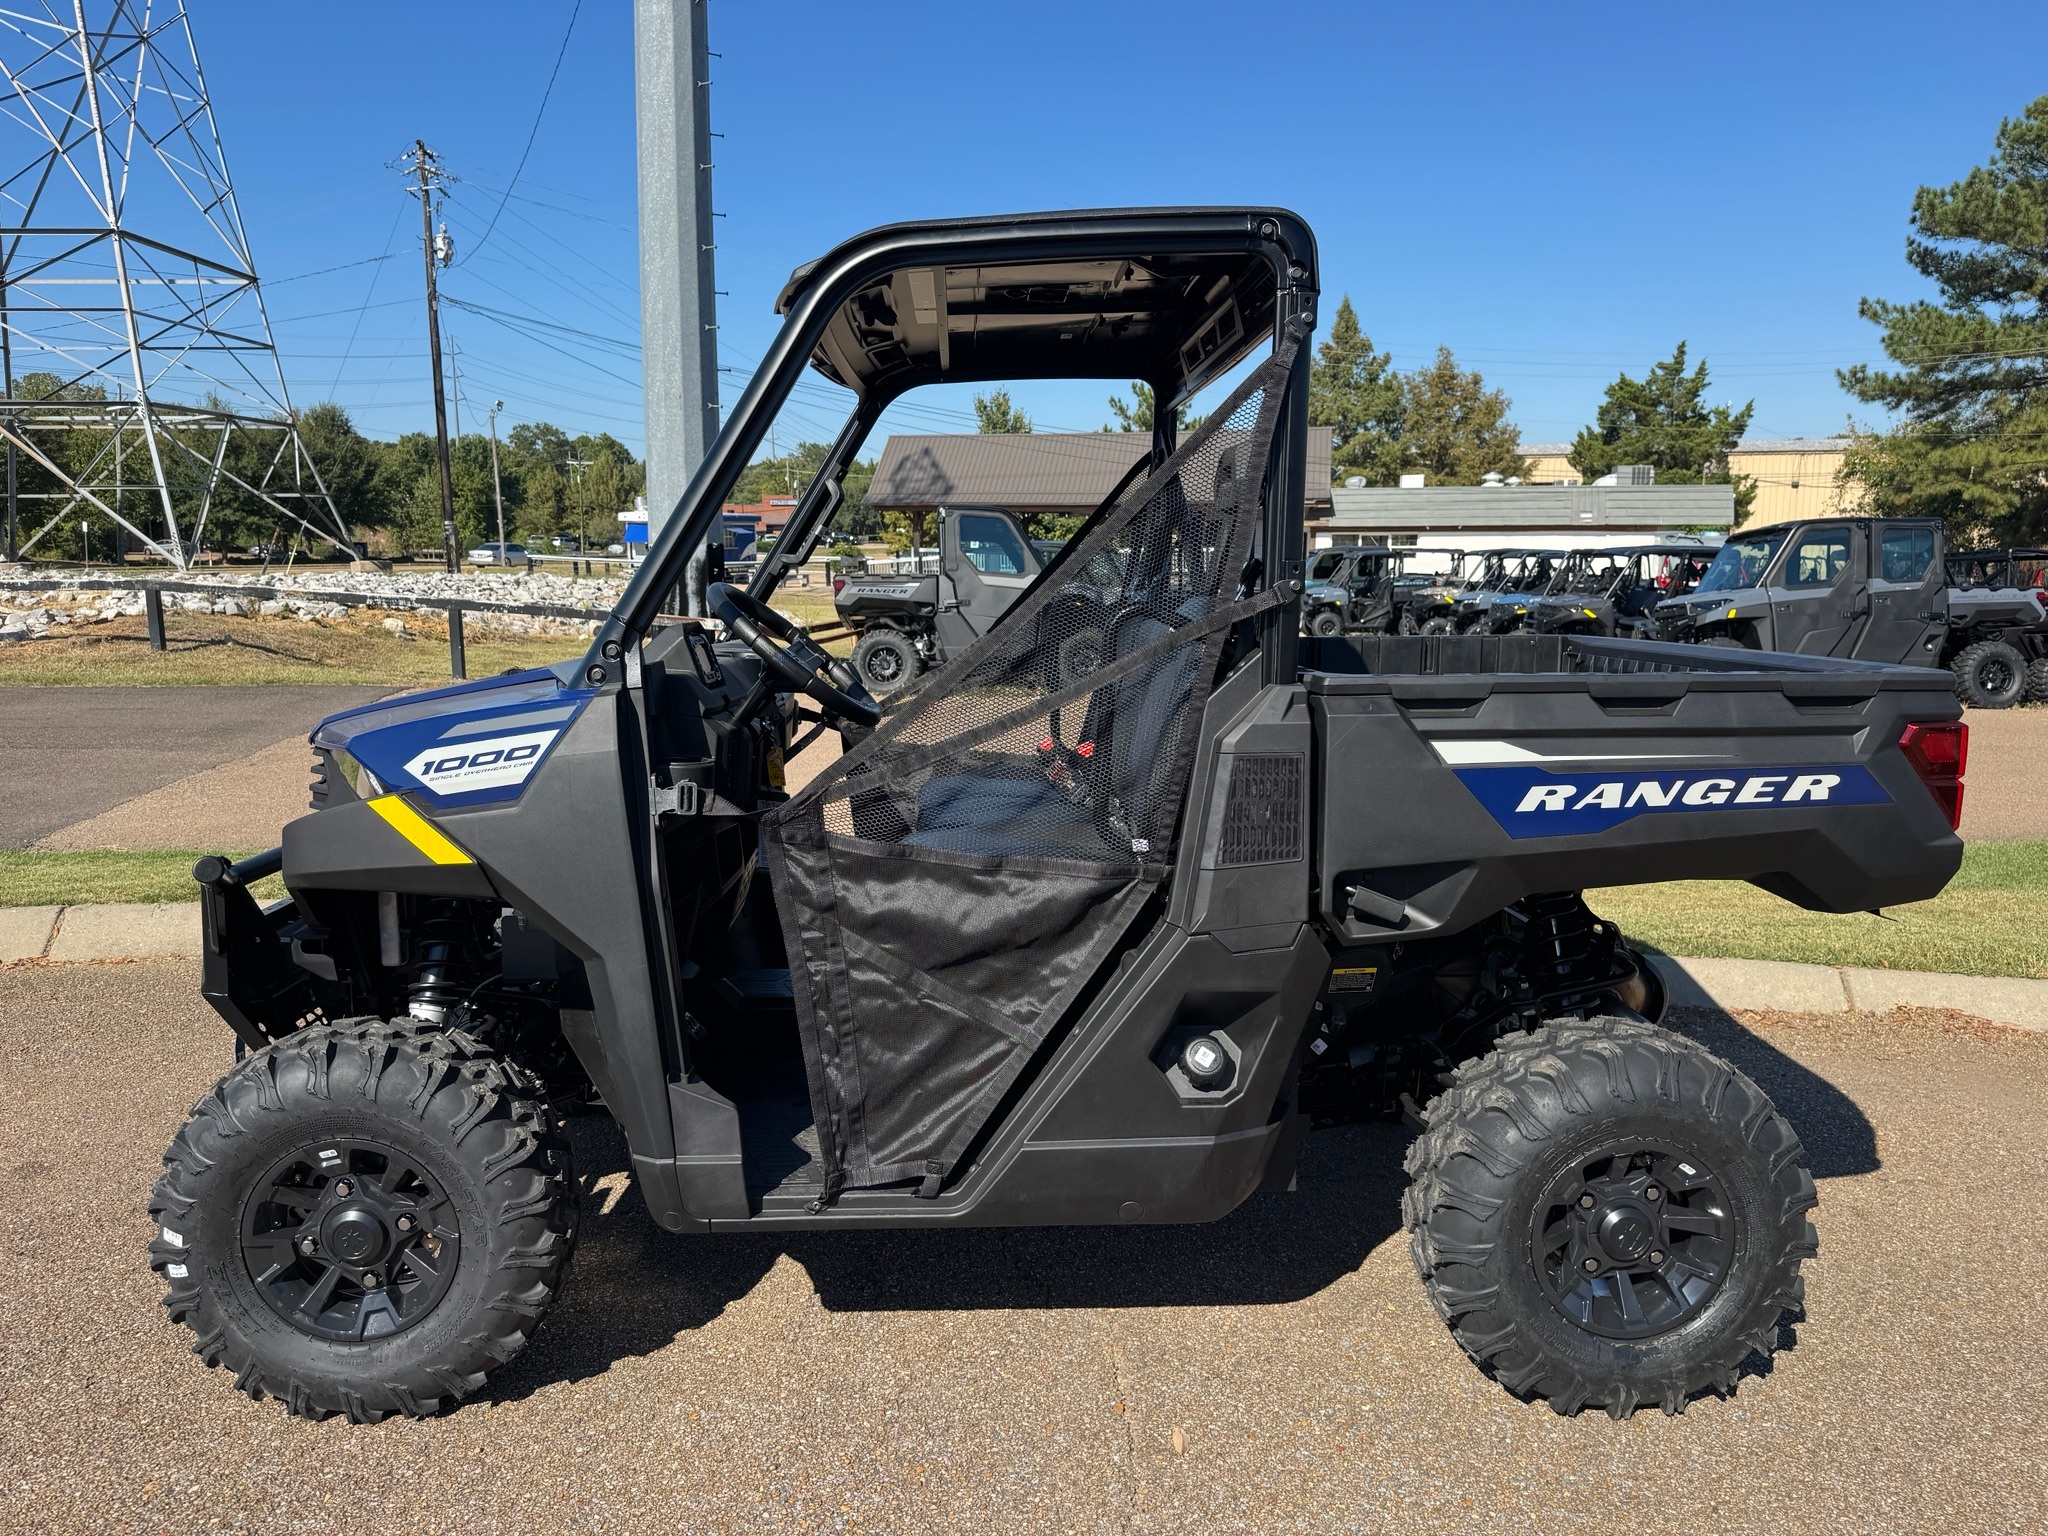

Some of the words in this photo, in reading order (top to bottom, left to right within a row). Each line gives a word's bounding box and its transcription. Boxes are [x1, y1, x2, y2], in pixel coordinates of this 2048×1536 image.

[421, 743, 541, 776] 1000
[428, 772, 462, 782] SINGLE
[464, 764, 512, 776] OVERHEAD
[512, 760, 535, 769] CAM
[1514, 774, 1841, 813] RANGER
[416, 1137, 488, 1247] CARLSTAR
